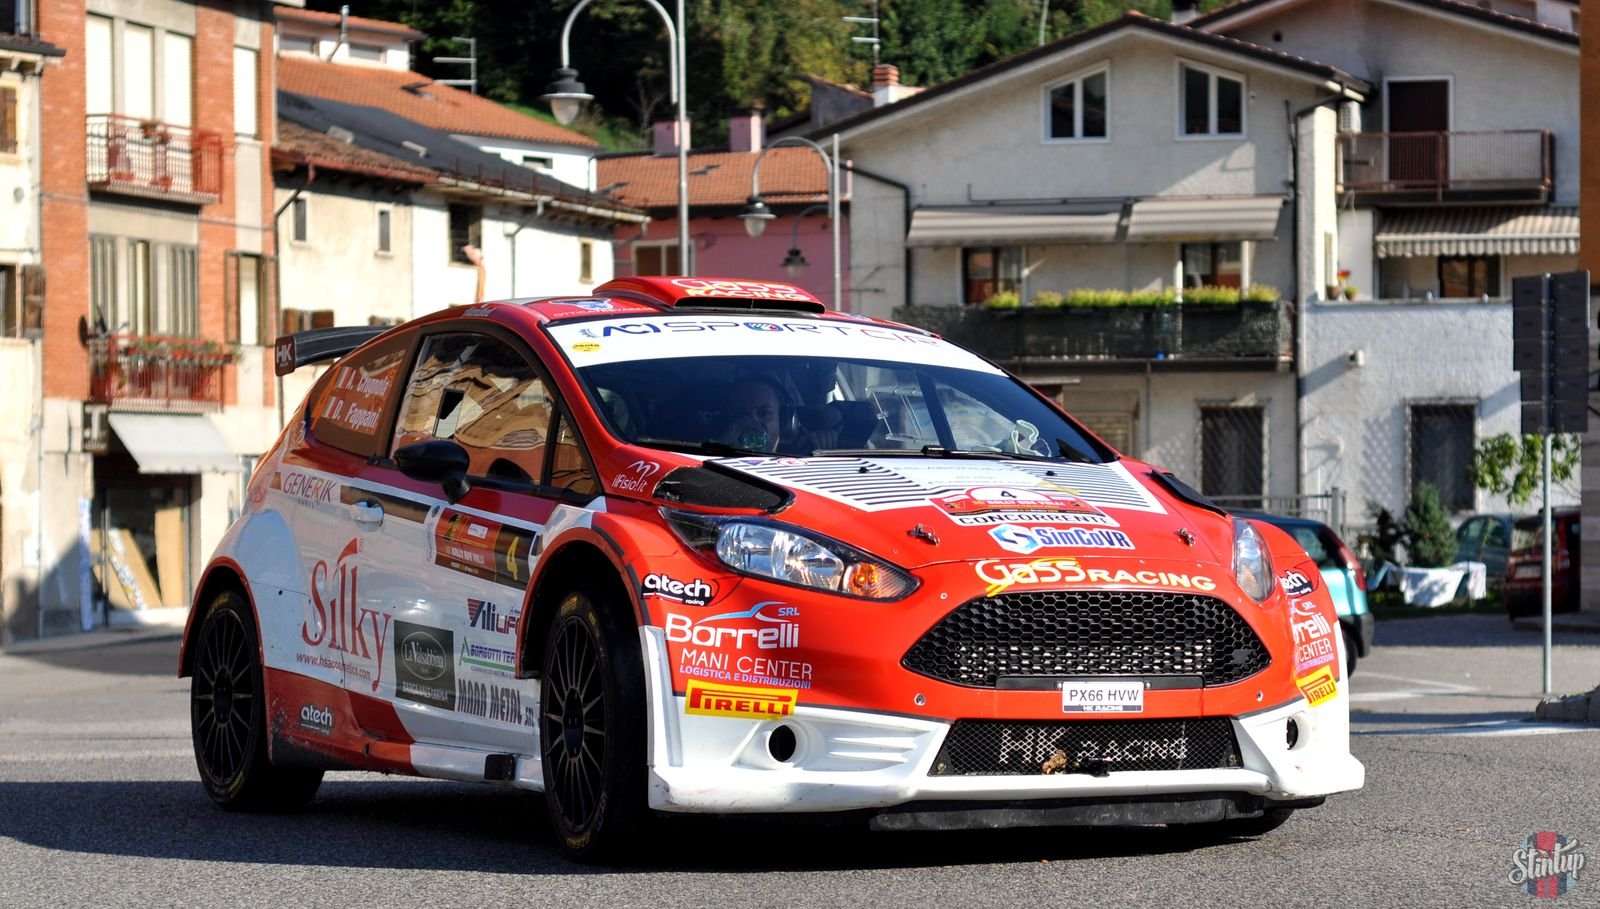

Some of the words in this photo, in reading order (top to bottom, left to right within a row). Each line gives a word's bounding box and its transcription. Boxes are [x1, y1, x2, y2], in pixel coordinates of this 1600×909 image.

[685, 289, 810, 300] RACING
[276, 343, 292, 363] HK
[344, 402, 382, 430] Fappani
[283, 472, 337, 503] GENERIK
[999, 490, 1017, 499] 4
[958, 512, 1114, 526] CONCORRENTE
[1034, 526, 1132, 548] SimCoVR
[506, 536, 519, 581] 4
[644, 573, 711, 598] atech
[975, 559, 1086, 586] Gass
[1086, 568, 1217, 591] RACING
[302, 538, 391, 692] Silky
[778, 607, 799, 617] SRL
[664, 613, 799, 650] Borrelli
[681, 648, 729, 670] MANI
[736, 656, 812, 680] CENTER
[680, 665, 731, 682] LOGISTICA
[734, 674, 740, 682] E
[741, 674, 811, 690] DISTRIBUZIONI
[1301, 673, 1337, 704] PIRELLI
[689, 687, 793, 715] PIRELLI
[1069, 689, 1104, 702] PX66
[1107, 689, 1140, 702] HVW
[301, 704, 333, 728] atech
[1000, 728, 1067, 763] HK
